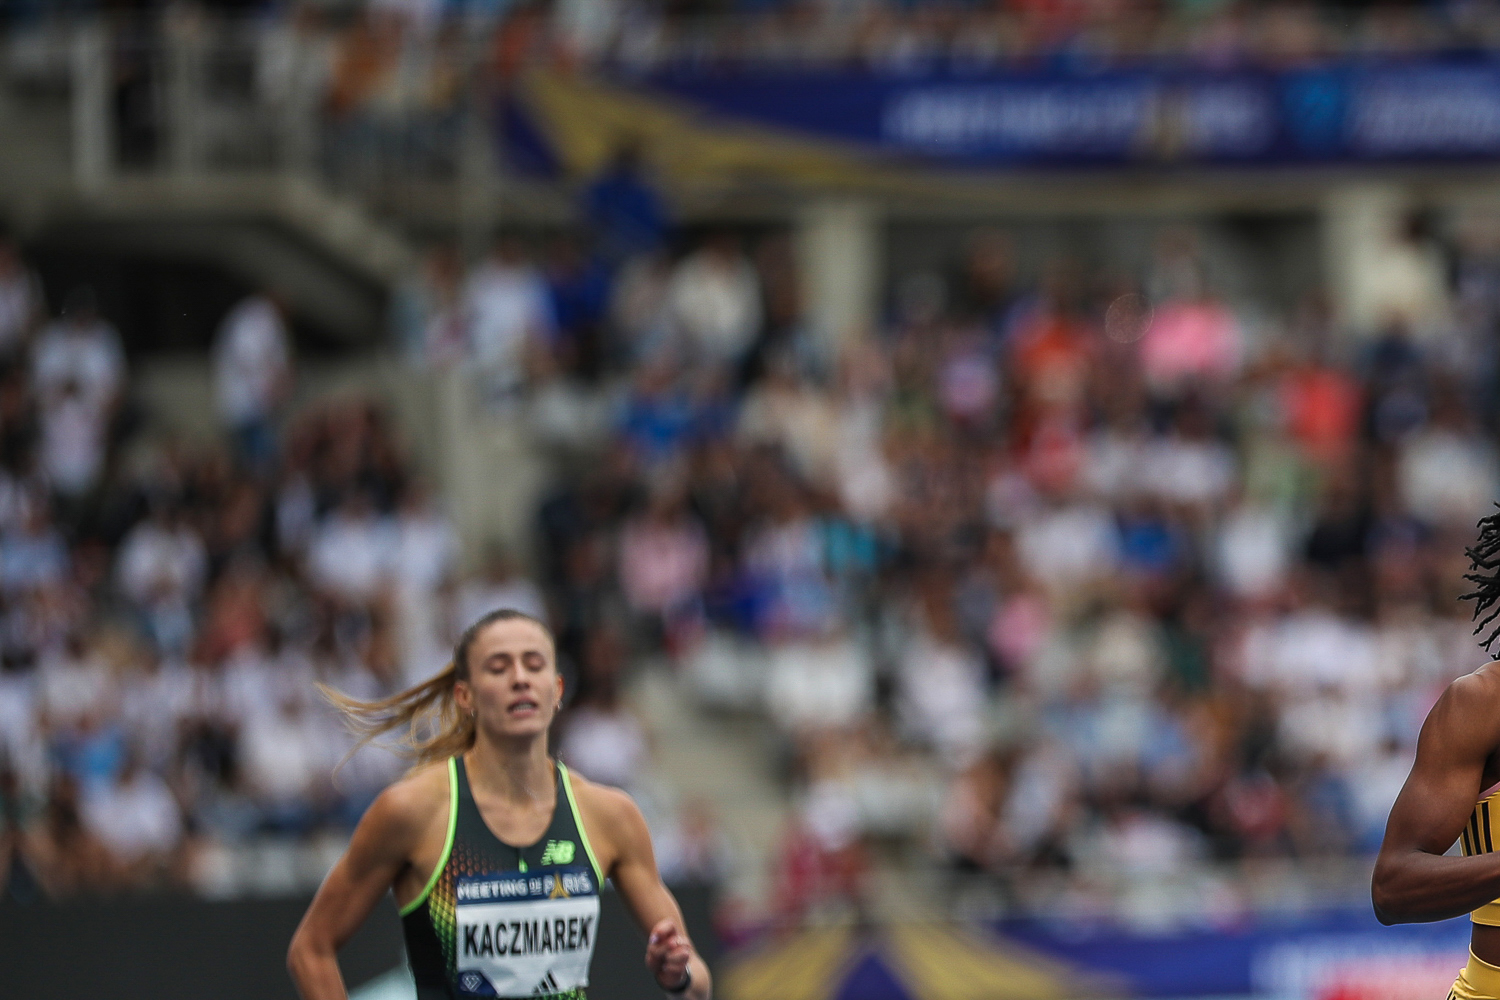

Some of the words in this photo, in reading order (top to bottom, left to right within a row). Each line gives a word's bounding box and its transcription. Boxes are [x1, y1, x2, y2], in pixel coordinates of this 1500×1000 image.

[457, 877, 529, 900] MEETING
[543, 871, 593, 899] PARIS
[464, 915, 593, 957] KACZMAREK
